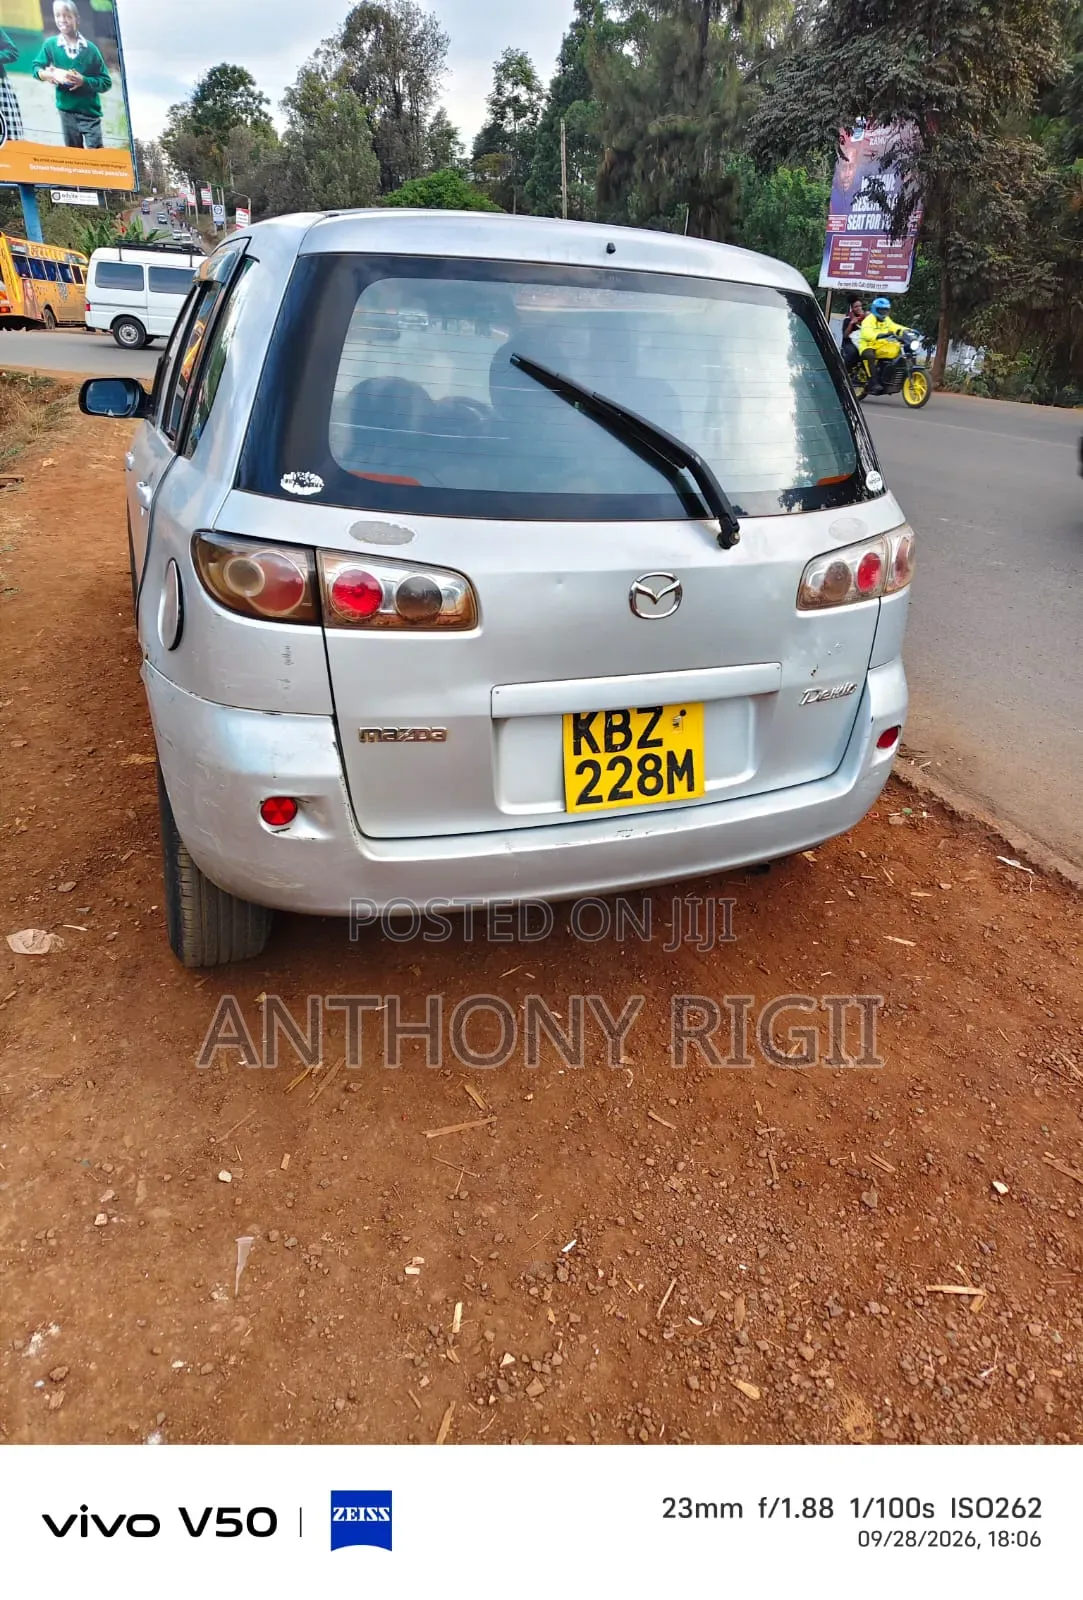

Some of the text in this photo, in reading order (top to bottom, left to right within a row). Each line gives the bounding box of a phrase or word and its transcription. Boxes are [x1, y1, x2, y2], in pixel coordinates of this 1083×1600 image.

[847, 213, 866, 231] SEAT
[865, 213, 882, 230] FOR
[572, 705, 664, 756] KBZ
[575, 748, 695, 806] 228M
